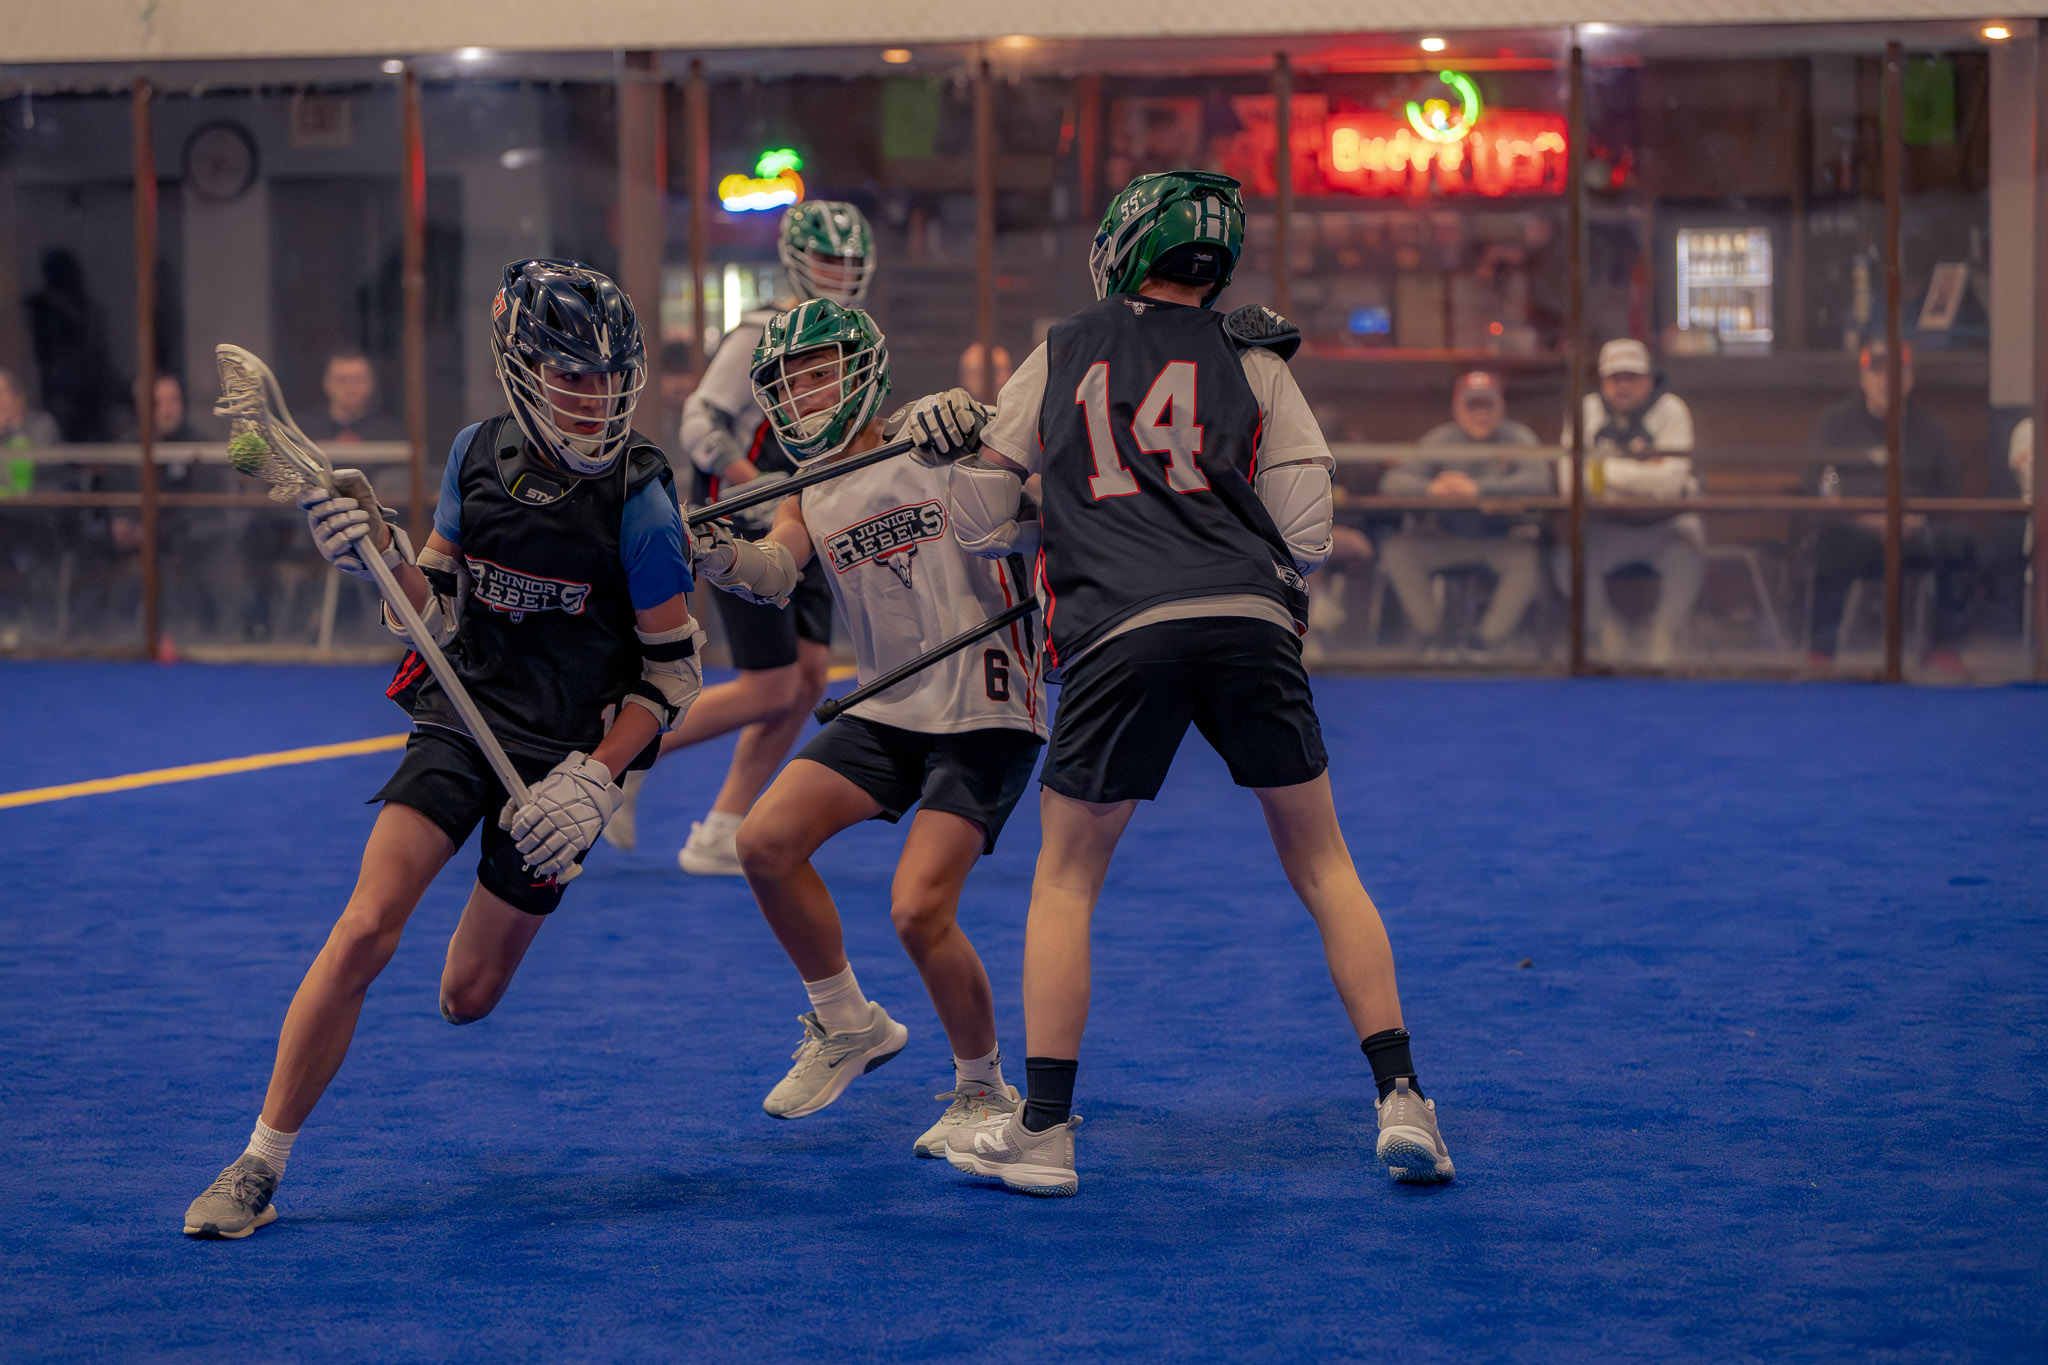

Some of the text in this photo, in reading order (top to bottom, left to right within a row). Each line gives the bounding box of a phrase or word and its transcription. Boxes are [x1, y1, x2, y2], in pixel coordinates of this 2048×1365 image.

[1075, 360, 1212, 501] 14
[525, 487, 555, 503] STX
[827, 503, 944, 569] REBELS
[855, 509, 918, 541] JUNIOR
[489, 569, 558, 597] JUNIOR
[983, 648, 1010, 702] 6
